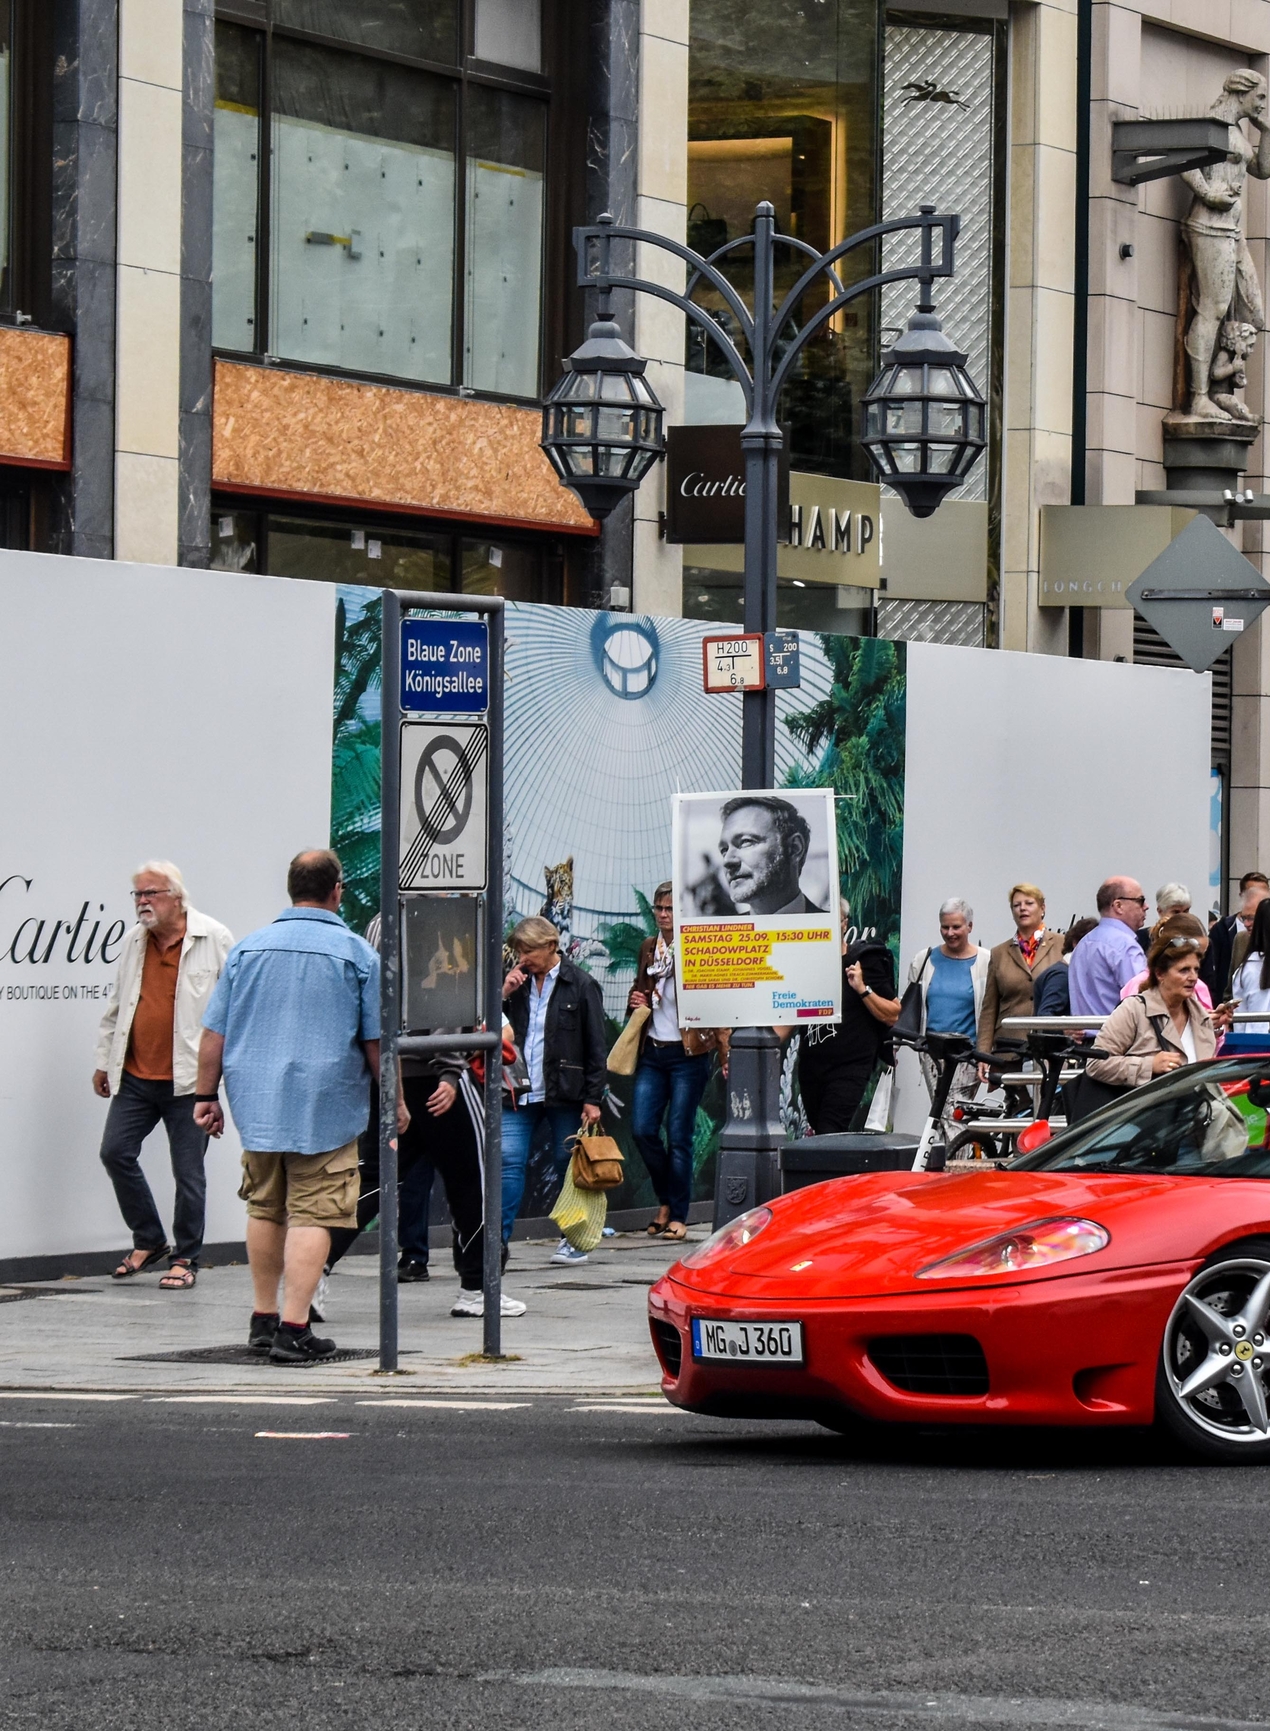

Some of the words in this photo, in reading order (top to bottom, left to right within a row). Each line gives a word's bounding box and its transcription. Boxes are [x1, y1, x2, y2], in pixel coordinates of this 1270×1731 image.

[1043, 580, 1132, 593] LONGCH
[407, 638, 446, 662] Blaue
[450, 640, 481, 663] Zone
[716, 641, 748, 654] H200
[783, 643, 798, 652] 200
[405, 669, 483, 698] Königsallee
[420, 854, 465, 879] ZONE
[722, 924, 752, 932] LINDNER
[684, 934, 733, 944] SAMSTAG
[738, 932, 770, 942] 25.09.
[776, 932, 804, 941] 15:30
[807, 930, 830, 940] UHR
[684, 945, 770, 956] SCHADOWPLATZ
[684, 958, 696, 968] IN
[700, 956, 765, 967] DÜSSELDORF
[7, 986, 60, 1000] BOUTIQUE
[62, 986, 78, 1000] ON
[80, 985, 100, 999] THE
[772, 991, 797, 1000] Freie
[772, 999, 834, 1008] Demokraten
[705, 1324, 728, 1354] MG
